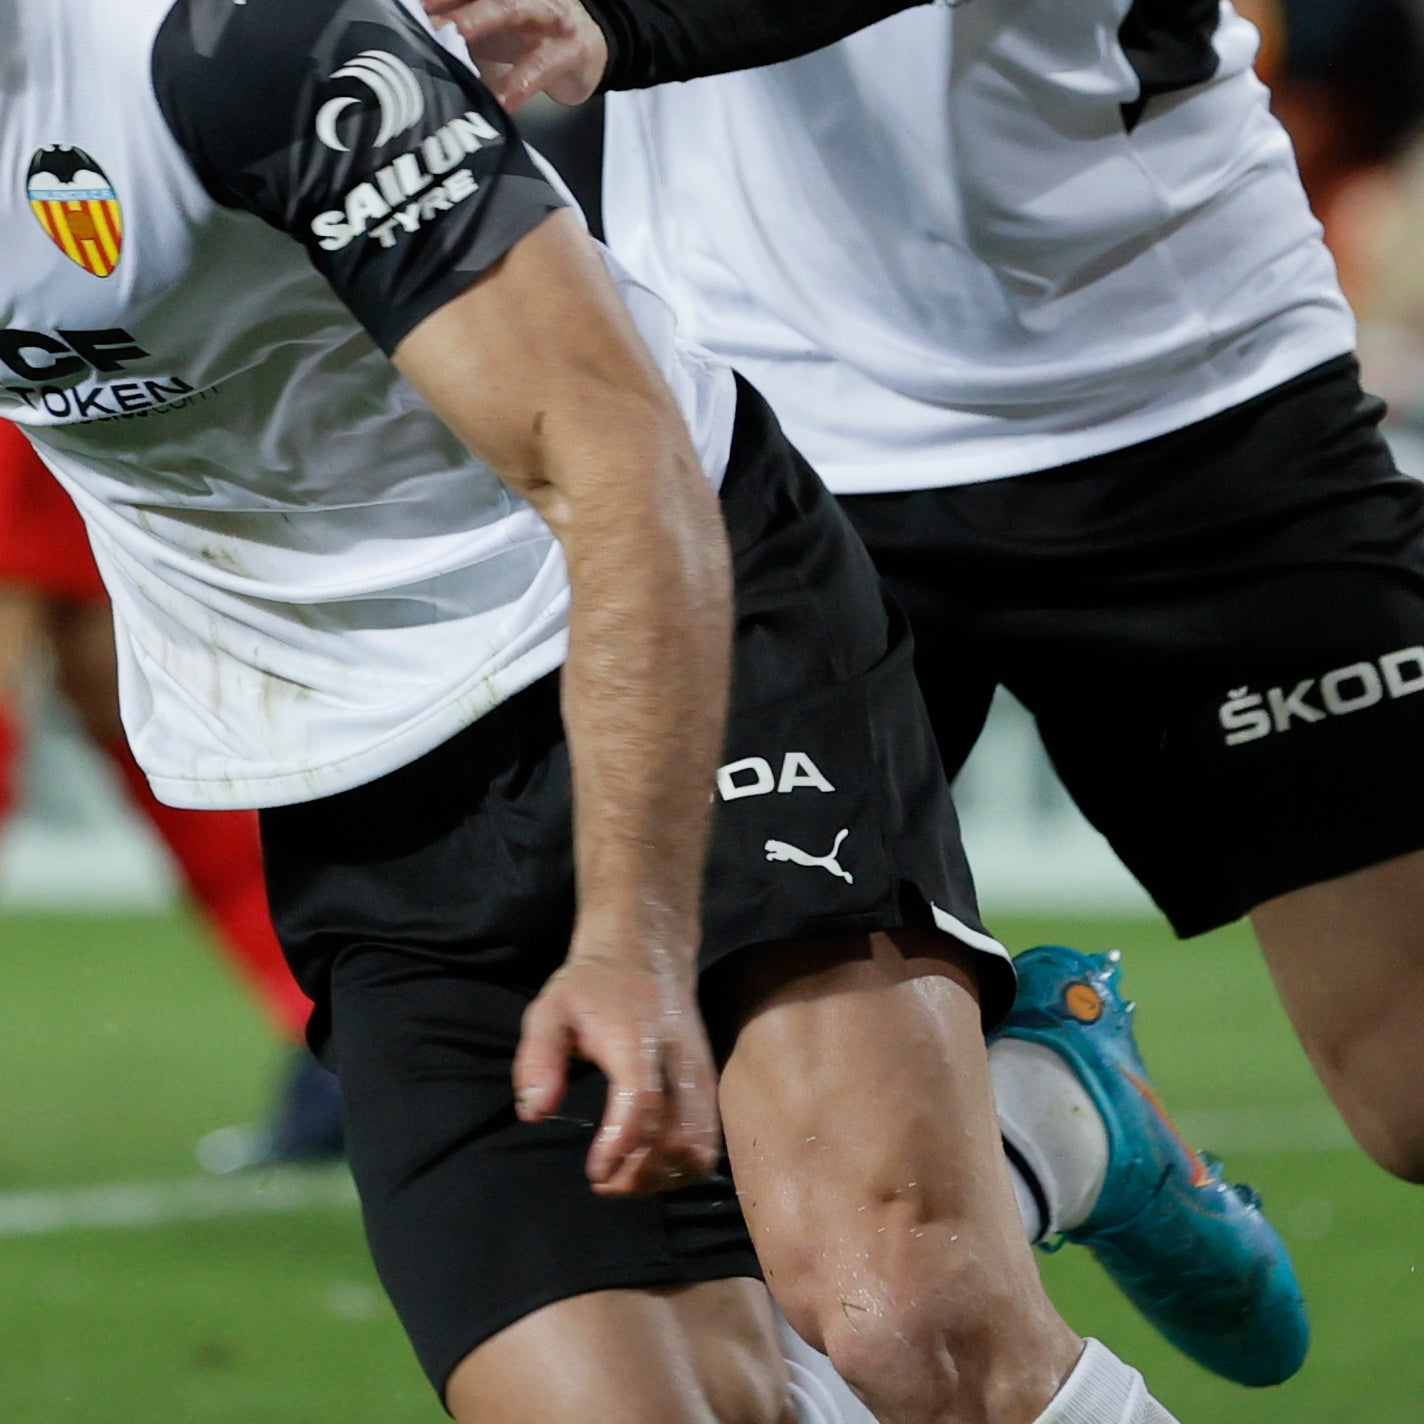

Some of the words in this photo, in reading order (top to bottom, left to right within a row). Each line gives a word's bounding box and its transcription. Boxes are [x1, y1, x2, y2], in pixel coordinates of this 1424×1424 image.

[311, 111, 501, 251] SAILUN
[368, 168, 480, 248] TYRE
[6, 376, 199, 418] TOKEN
[709, 752, 837, 801] DA
